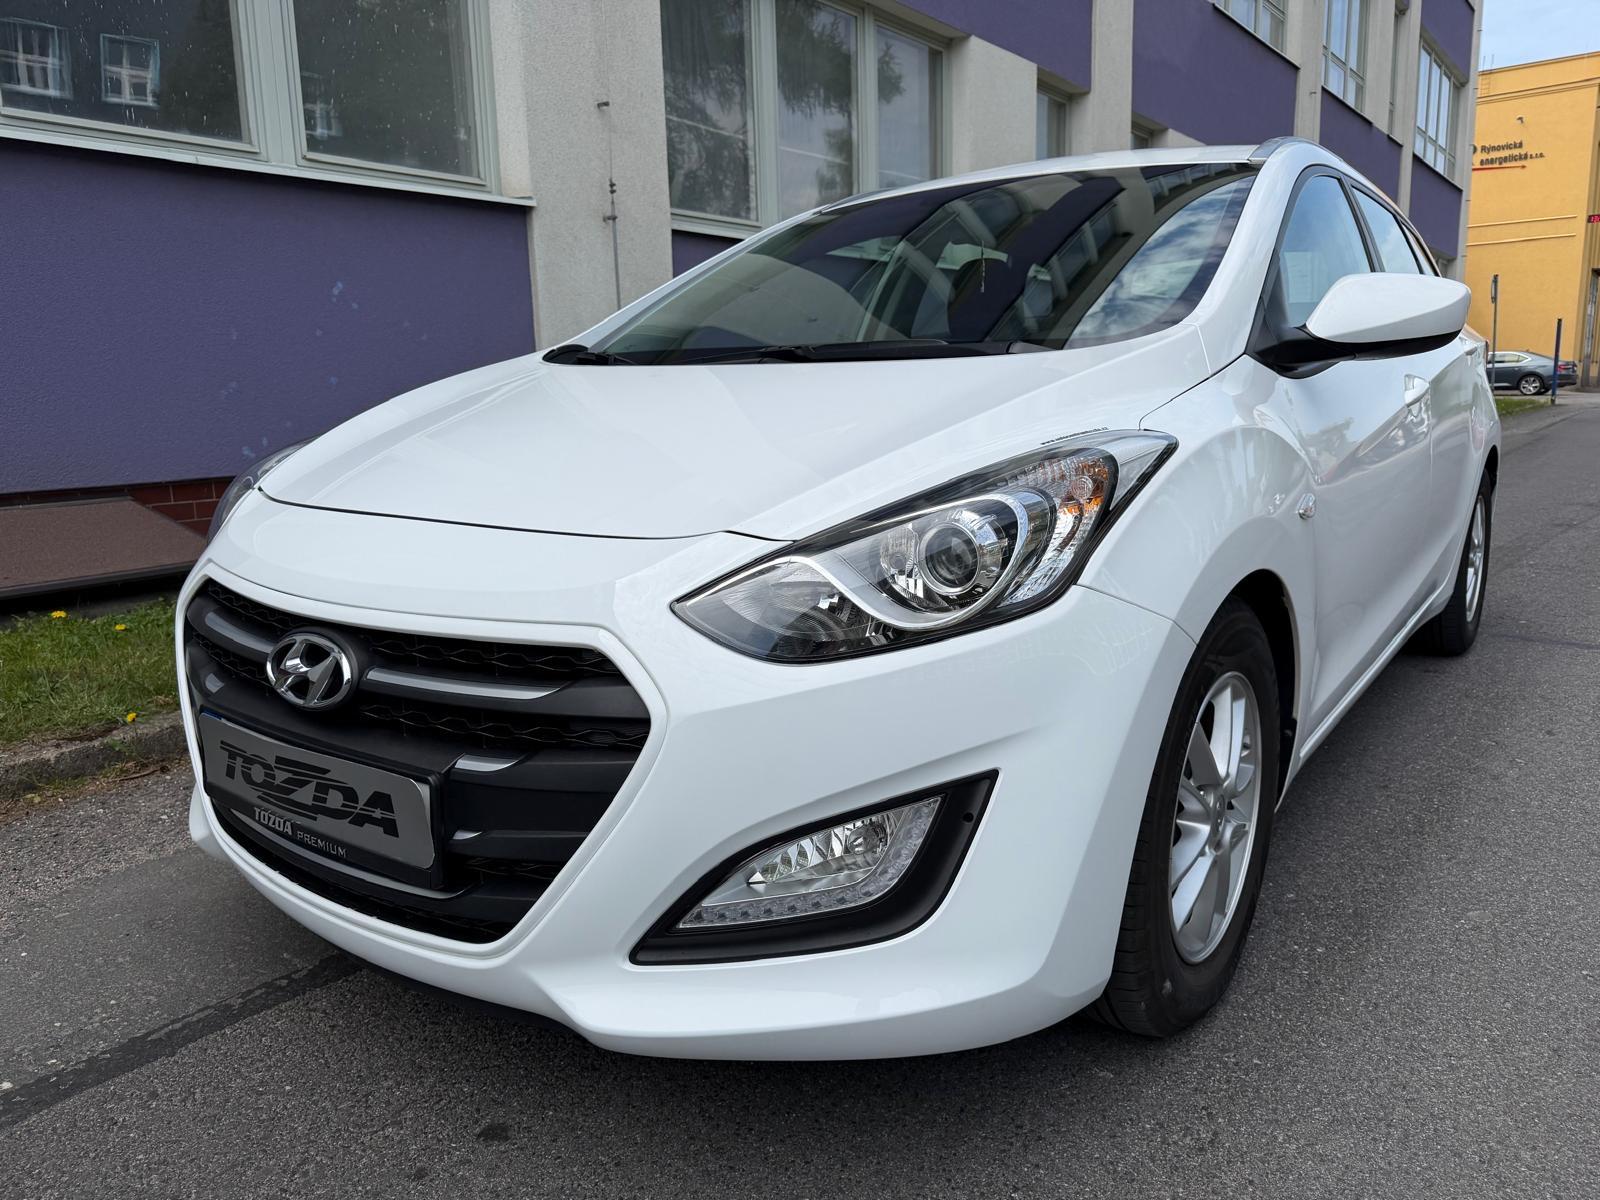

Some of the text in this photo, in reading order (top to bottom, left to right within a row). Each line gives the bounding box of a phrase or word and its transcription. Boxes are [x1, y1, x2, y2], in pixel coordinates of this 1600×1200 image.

[1480, 140, 1523, 154] Rýnovická
[1480, 151, 1528, 166] energetická
[253, 806, 347, 858] TOZDA PREMIUM
